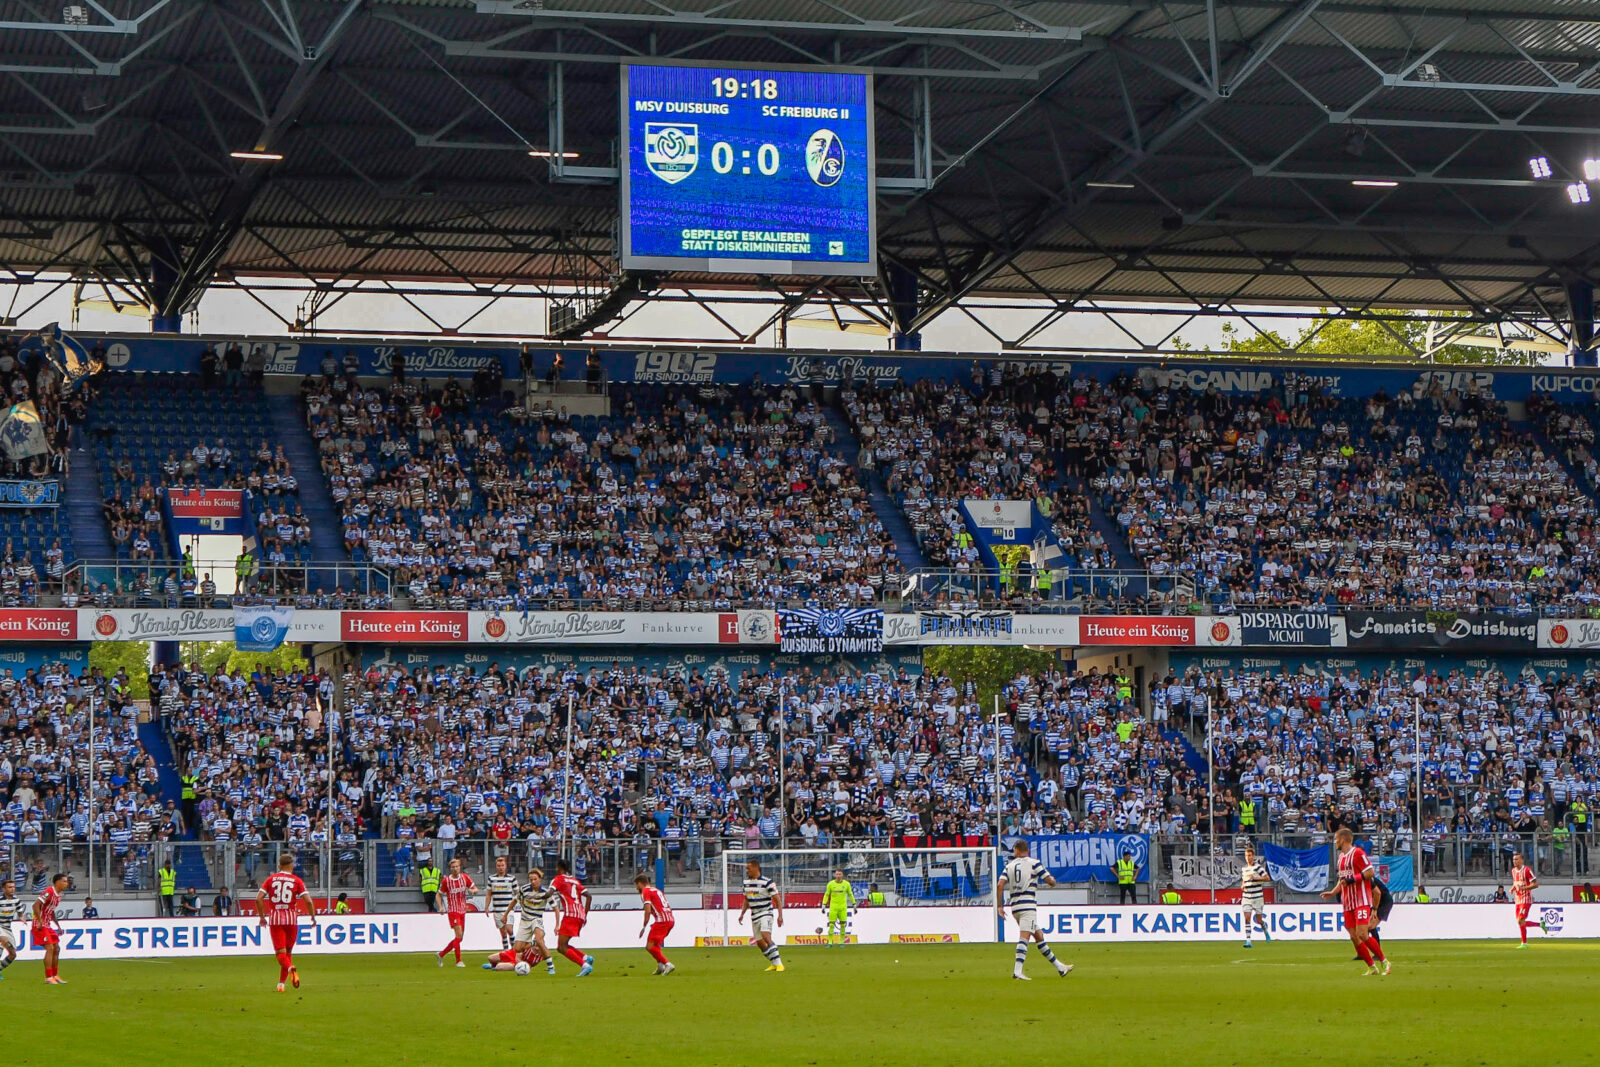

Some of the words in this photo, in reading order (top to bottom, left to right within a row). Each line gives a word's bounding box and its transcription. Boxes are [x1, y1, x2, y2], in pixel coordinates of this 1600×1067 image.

[711, 77, 778, 99] 19:18
[635, 101, 664, 112] MSV
[666, 102, 729, 115] DUISBURG
[762, 105, 778, 117] SC
[780, 106, 838, 119] FREIBURG
[841, 108, 849, 119] II
[682, 229, 738, 241] GEPFLEGT
[741, 230, 810, 243] ESKALIEREN
[682, 240, 713, 251] STATT
[263, 363, 296, 373] DABEI
[371, 347, 427, 371] Knig
[635, 351, 717, 374] 1902
[784, 356, 836, 380] Kög
[838, 356, 902, 378] Plsener
[634, 372, 654, 381] WIR
[656, 372, 680, 381] SIND
[683, 373, 713, 382] DABEI
[1167, 368, 1273, 392] SCANIA
[43, 483, 59, 502] 47
[170, 497, 197, 507] Heute
[198, 498, 212, 507] ein
[213, 497, 240, 510] König
[214, 520, 220, 528] 9
[1004, 529, 1013, 538] 10
[0, 617, 22, 631] ein
[26, 617, 70, 636] König
[128, 613, 179, 636] König
[179, 610, 235, 631] Pilsene
[349, 619, 392, 633] Heute
[394, 619, 412, 633] ein
[419, 620, 462, 638] König
[515, 613, 565, 638] König
[565, 612, 626, 633] Pilsener
[642, 622, 704, 633] Fankurve
[886, 617, 919, 639] Kön
[1014, 624, 1065, 635] ankurve
[1242, 612, 1330, 630] DISPARGUM
[1350, 616, 1437, 639] Fanatics
[1446, 618, 1537, 641] Duisburg
[1086, 624, 1126, 637] Heute
[1128, 624, 1146, 637] ein
[1151, 624, 1190, 642] König
[1268, 629, 1305, 643] MCMII
[780, 637, 826, 653] DUISBURG
[828, 637, 883, 653] DYNAMITES
[407, 653, 429, 664] DIETZ
[1014, 862, 1022, 884] 6
[271, 880, 294, 904] 36
[1042, 912, 1122, 935] JETZT
[1132, 912, 1241, 934] KARTEN
[1357, 909, 1368, 920] 25
[16, 928, 103, 951] JZT
[114, 925, 262, 950] STREIFEN
[295, 922, 400, 946] EIGEN!
[897, 934, 937, 944] Sinalco
